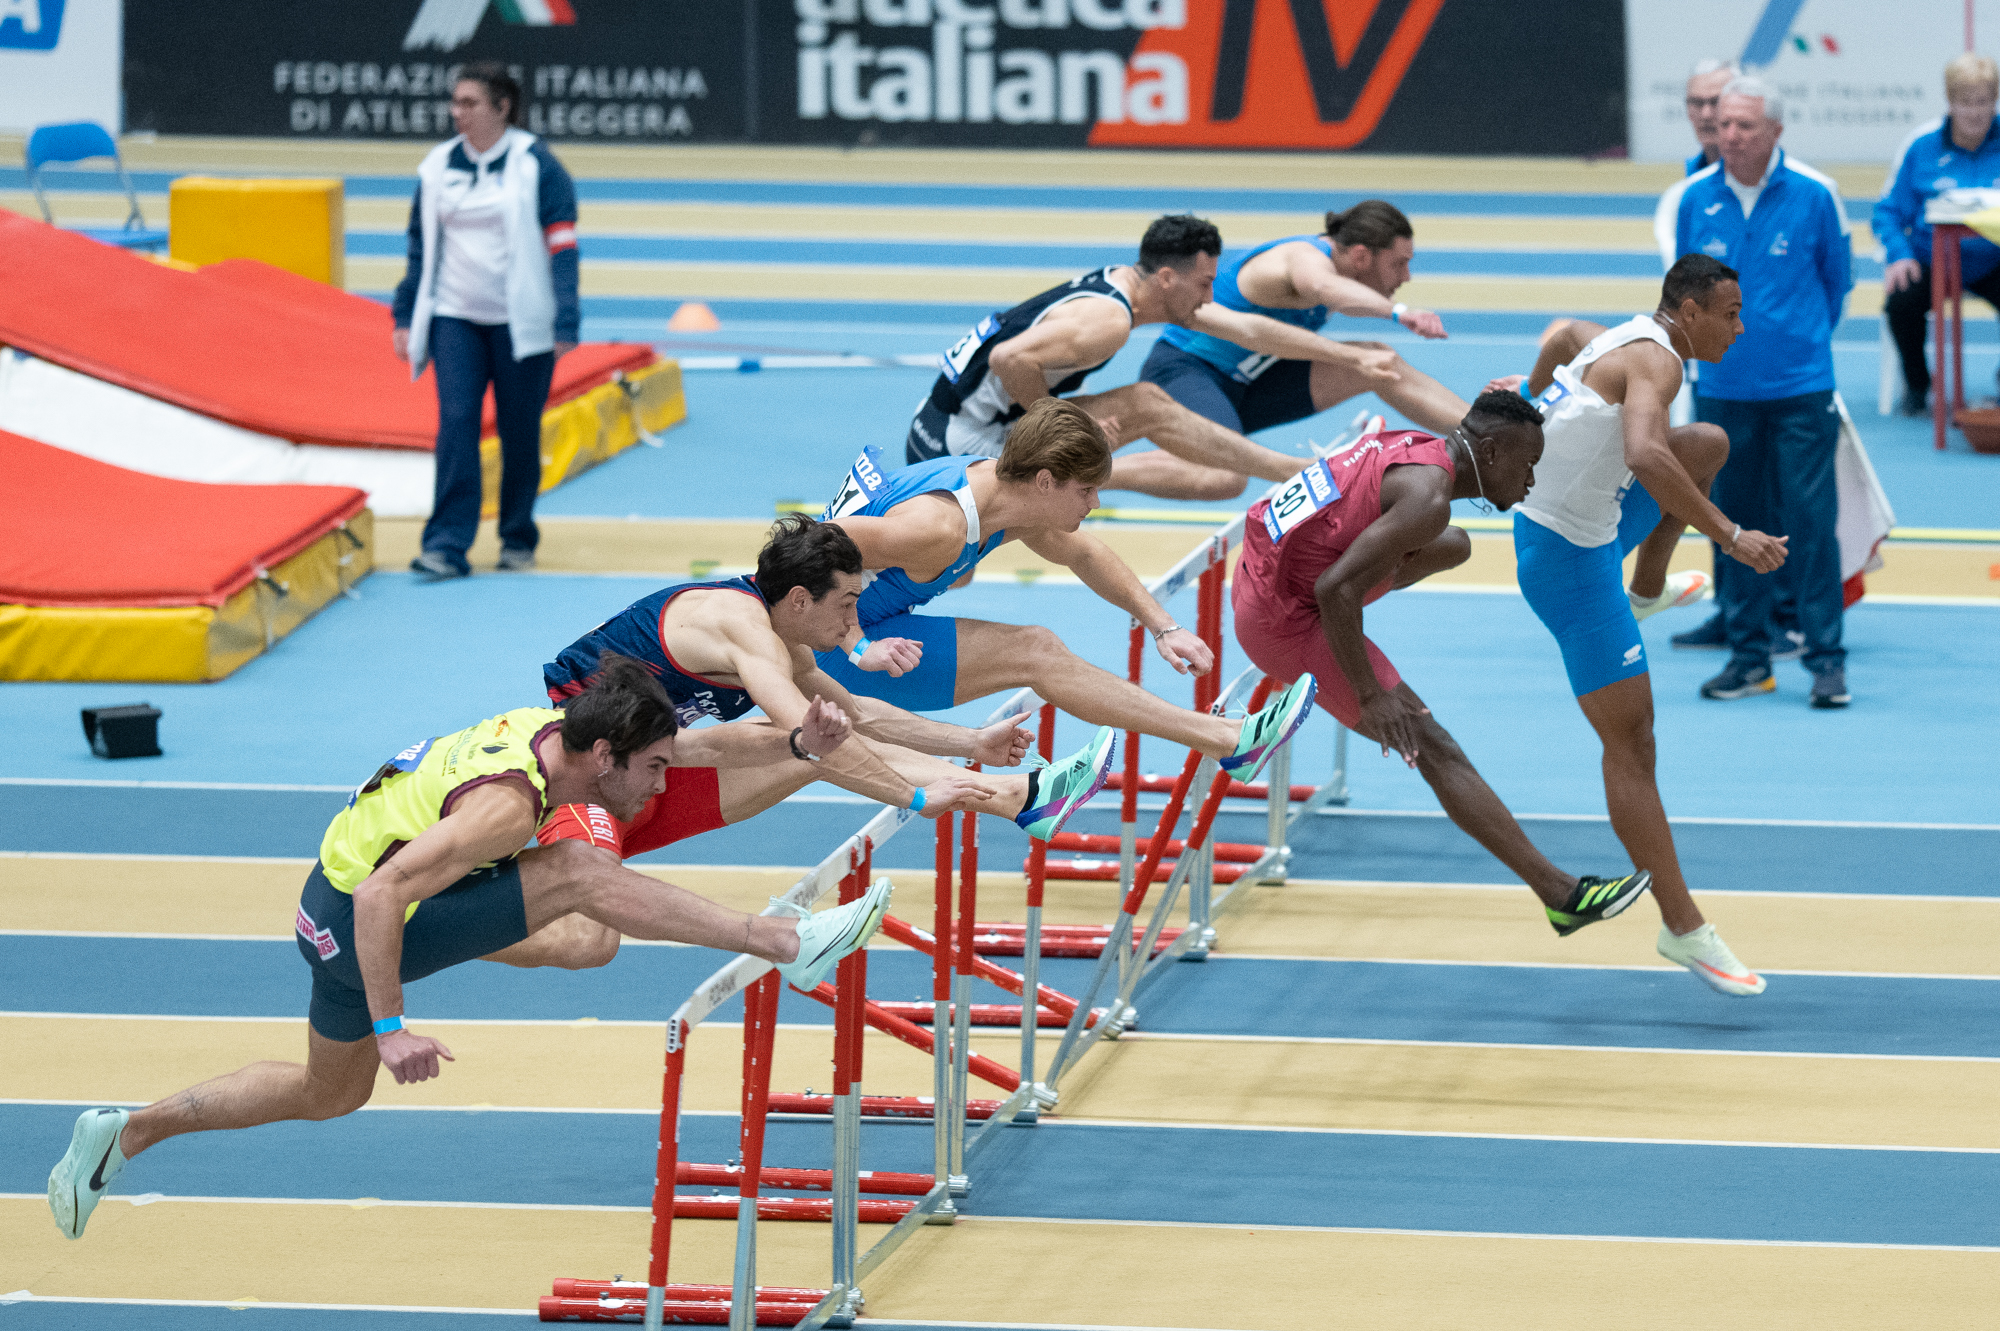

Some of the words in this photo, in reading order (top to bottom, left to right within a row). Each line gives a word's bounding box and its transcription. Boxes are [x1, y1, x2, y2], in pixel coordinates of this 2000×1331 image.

[274, 61, 523, 96] FEDERAZI
[534, 65, 708, 98] ITALIANA
[797, 20, 1190, 125] italiana
[290, 100, 331, 131] DI
[529, 103, 692, 136] LEGGERA
[1274, 482, 1307, 519] 90
